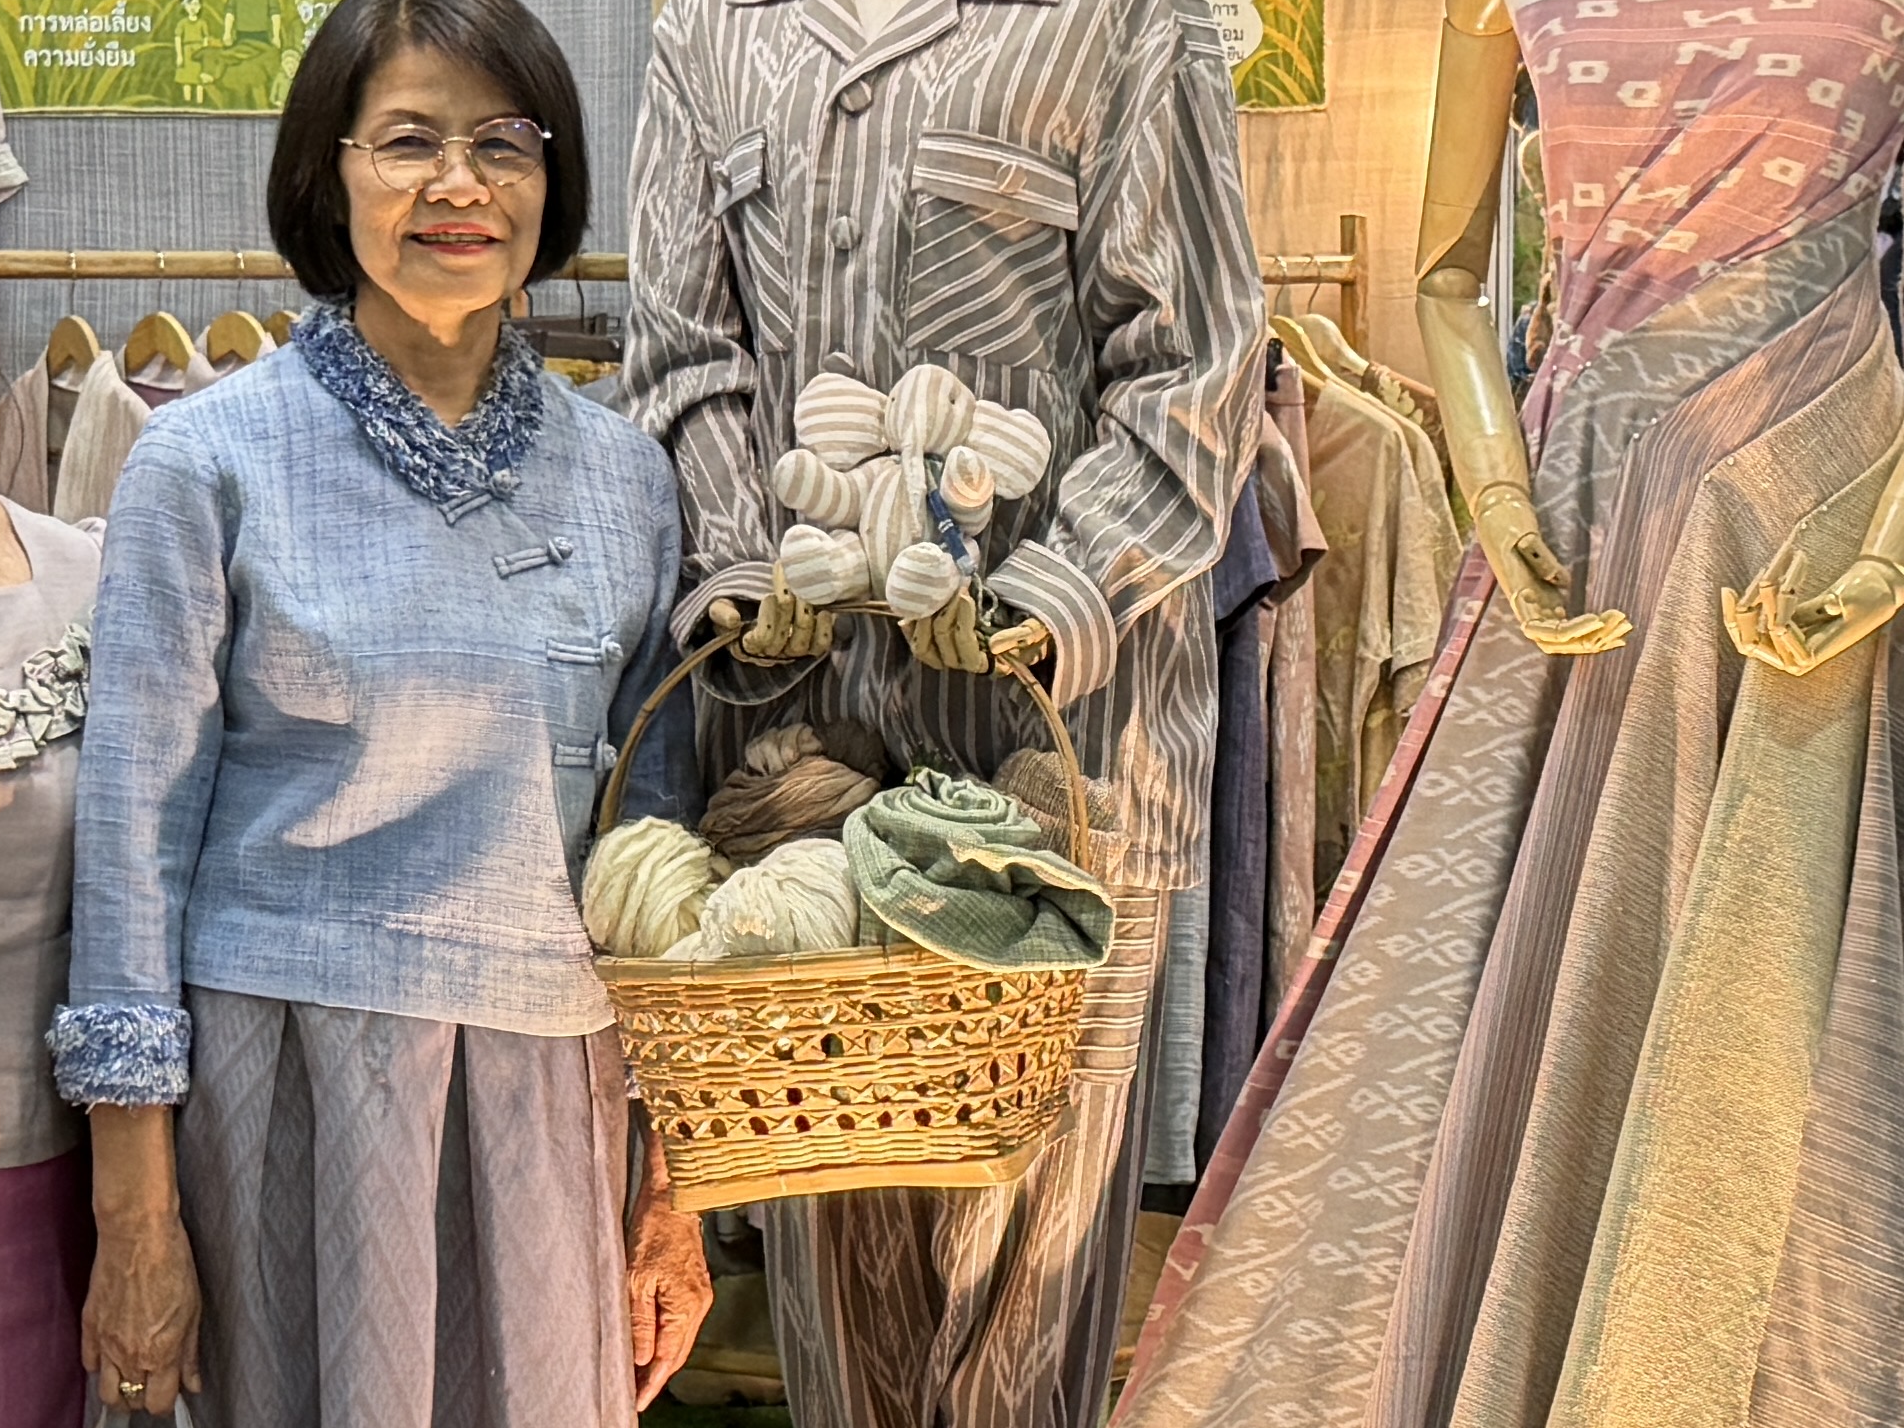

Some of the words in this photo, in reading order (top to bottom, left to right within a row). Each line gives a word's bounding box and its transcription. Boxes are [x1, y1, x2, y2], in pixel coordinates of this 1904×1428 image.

[18, 0, 153, 34] การหล่อเลี้ยง
[23, 35, 137, 68] ความยั่งยืน
